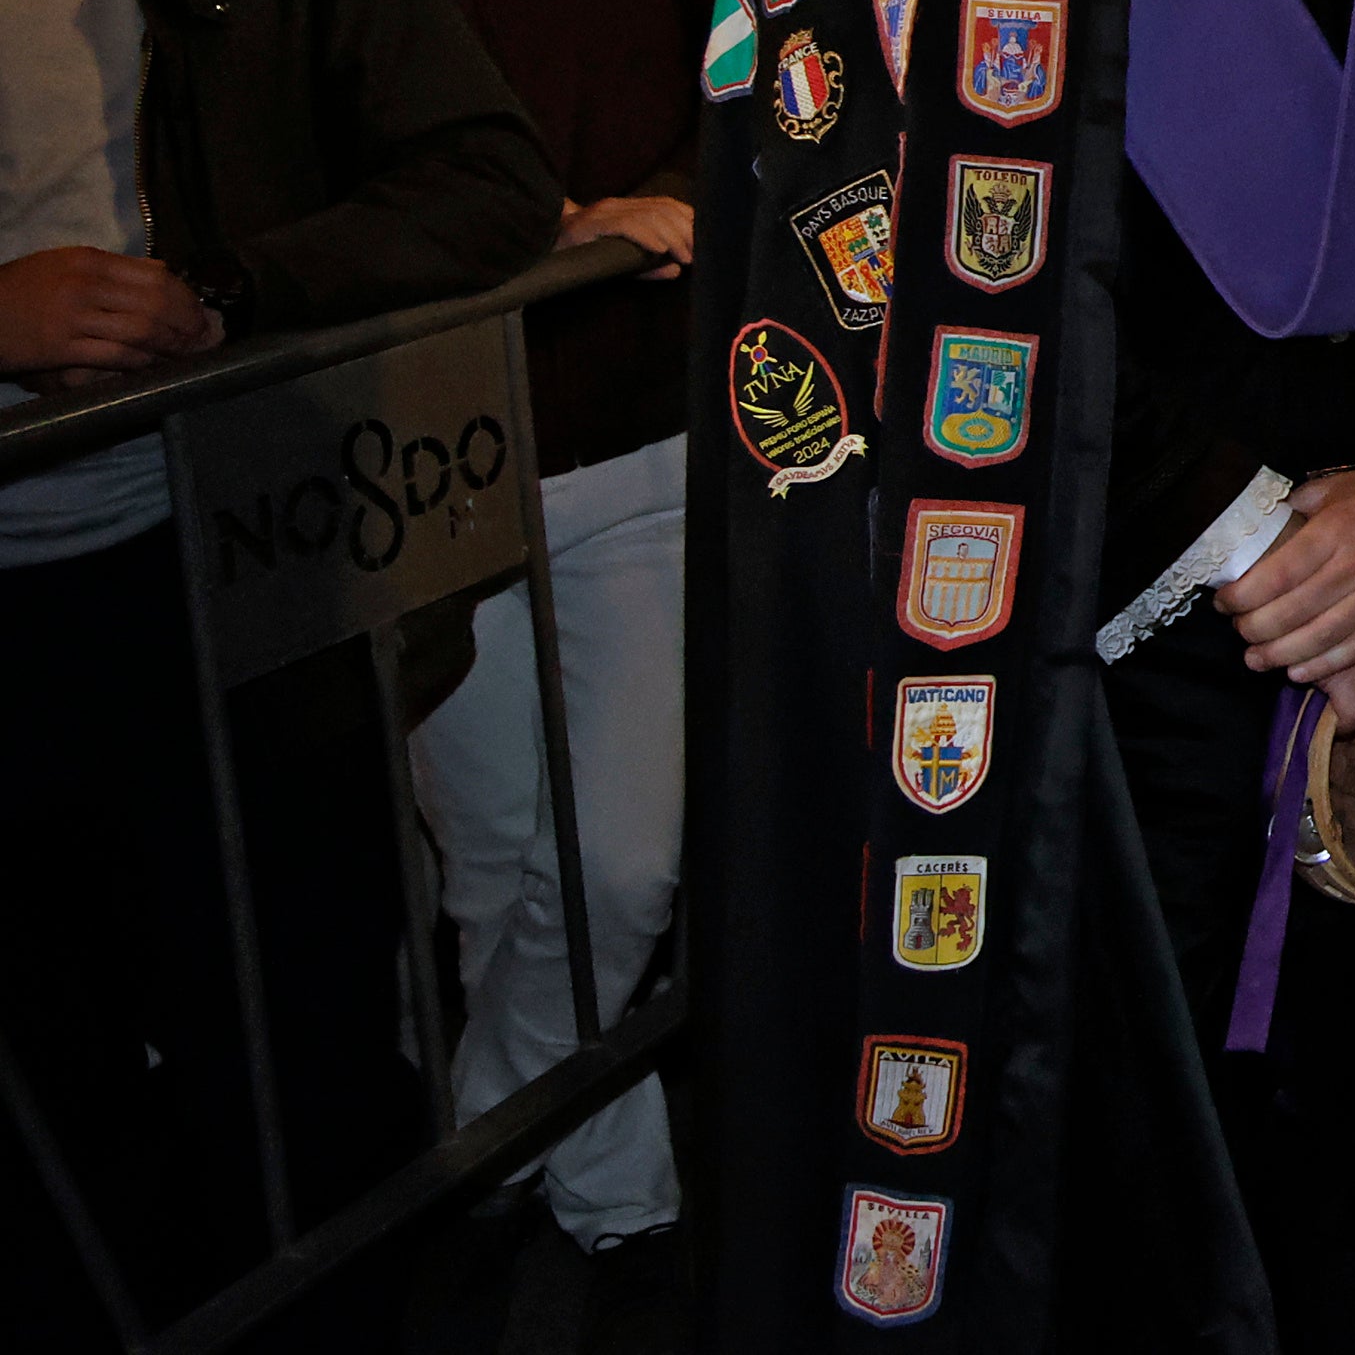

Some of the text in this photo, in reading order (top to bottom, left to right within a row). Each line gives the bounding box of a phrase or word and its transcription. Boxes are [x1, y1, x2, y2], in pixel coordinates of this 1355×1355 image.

[987, 8, 1042, 22] SEVILLA
[777, 42, 820, 71] FRANCE
[973, 169, 1028, 186] TOLEDO
[801, 185, 889, 240] PAYS BASQUE
[743, 360, 807, 403] TVNA
[792, 436, 831, 464] 2024
[928, 524, 1001, 541] SEGOVIA
[906, 688, 986, 704] VATICANO
[879, 1050, 952, 1068] AVILA
[866, 1201, 931, 1220] SEVILLA
